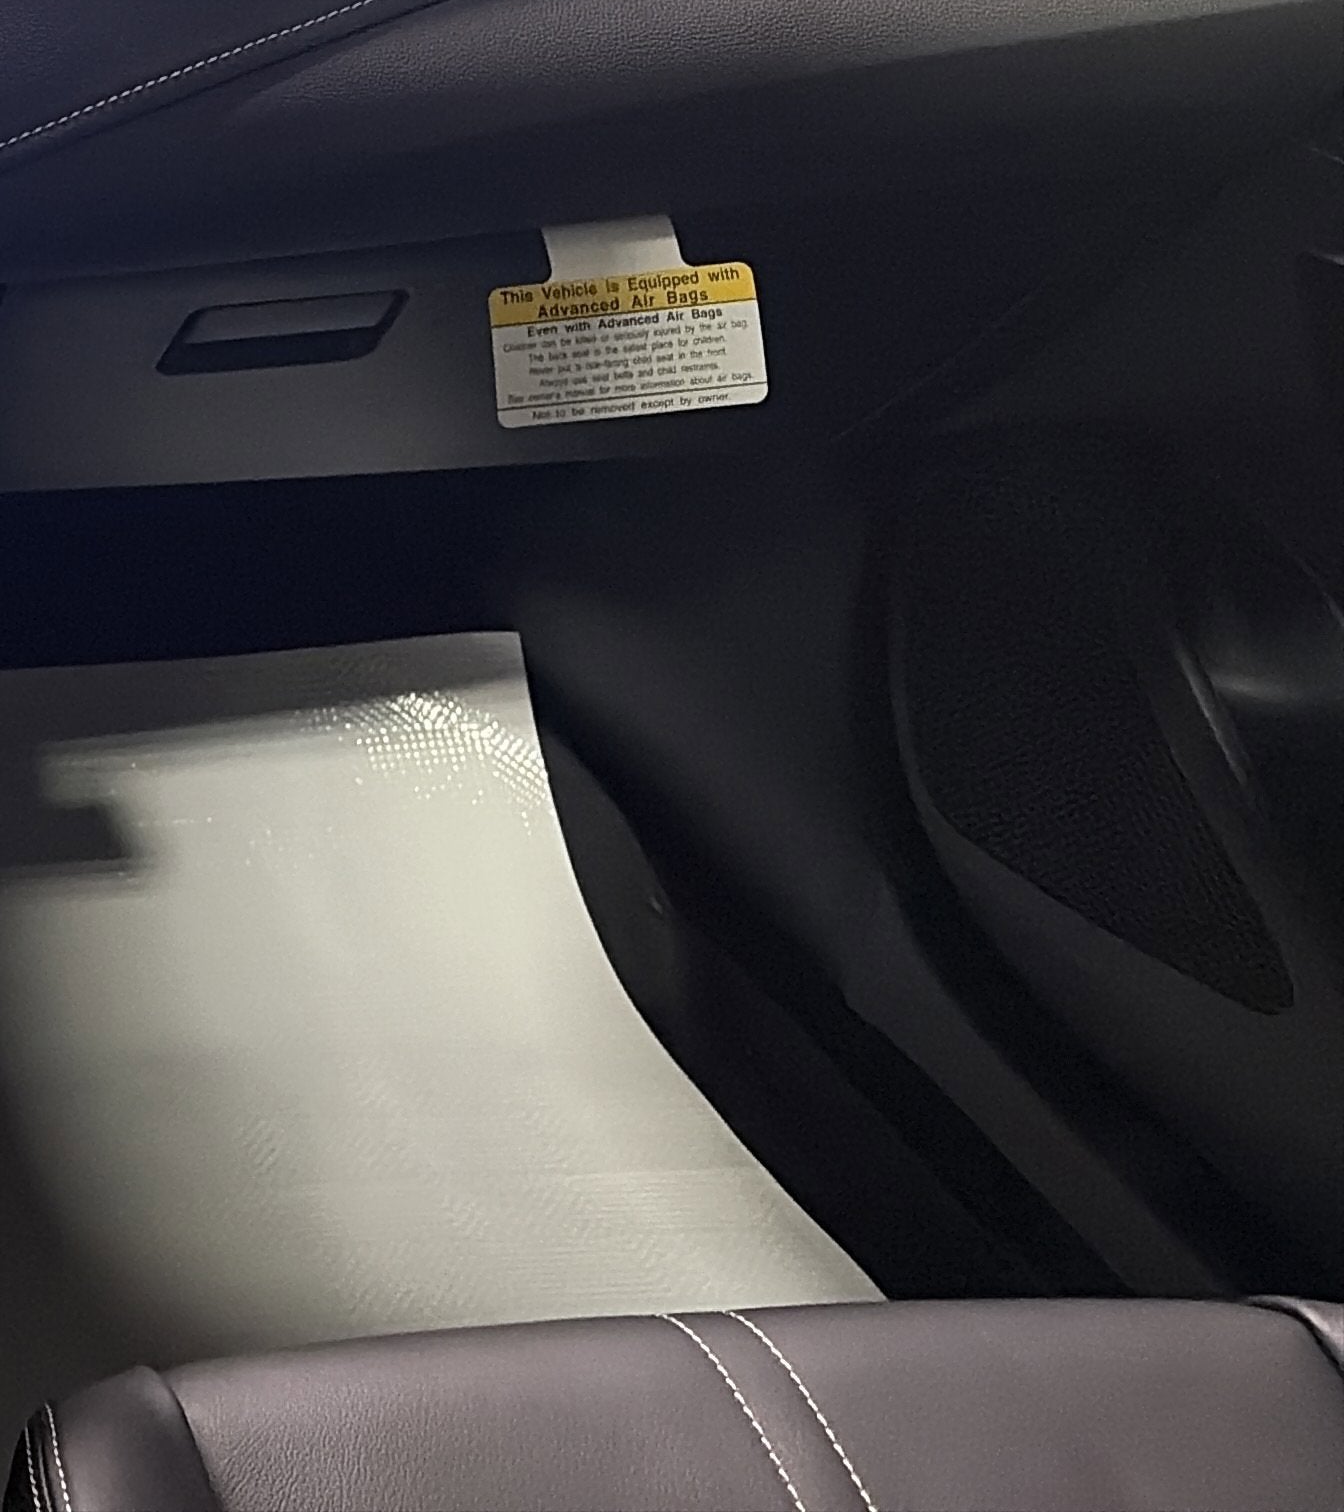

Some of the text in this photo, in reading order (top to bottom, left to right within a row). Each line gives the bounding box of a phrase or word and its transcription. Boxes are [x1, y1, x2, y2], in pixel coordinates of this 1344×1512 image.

[499, 289, 534, 305] This
[541, 282, 598, 300] Vehicle
[628, 271, 699, 292] Equipped
[707, 267, 740, 282] with
[538, 290, 709, 318] Advanced Air Bags
[527, 308, 723, 337] Even with Advanced Air Bags
[684, 325, 695, 334] by
[699, 322, 711, 330] the
[690, 349, 703, 358] the
[638, 368, 653, 377] and
[690, 375, 713, 385] about
[555, 408, 566, 418] to
[572, 407, 585, 417] be
[640, 399, 674, 408] except
[680, 396, 692, 406] by
